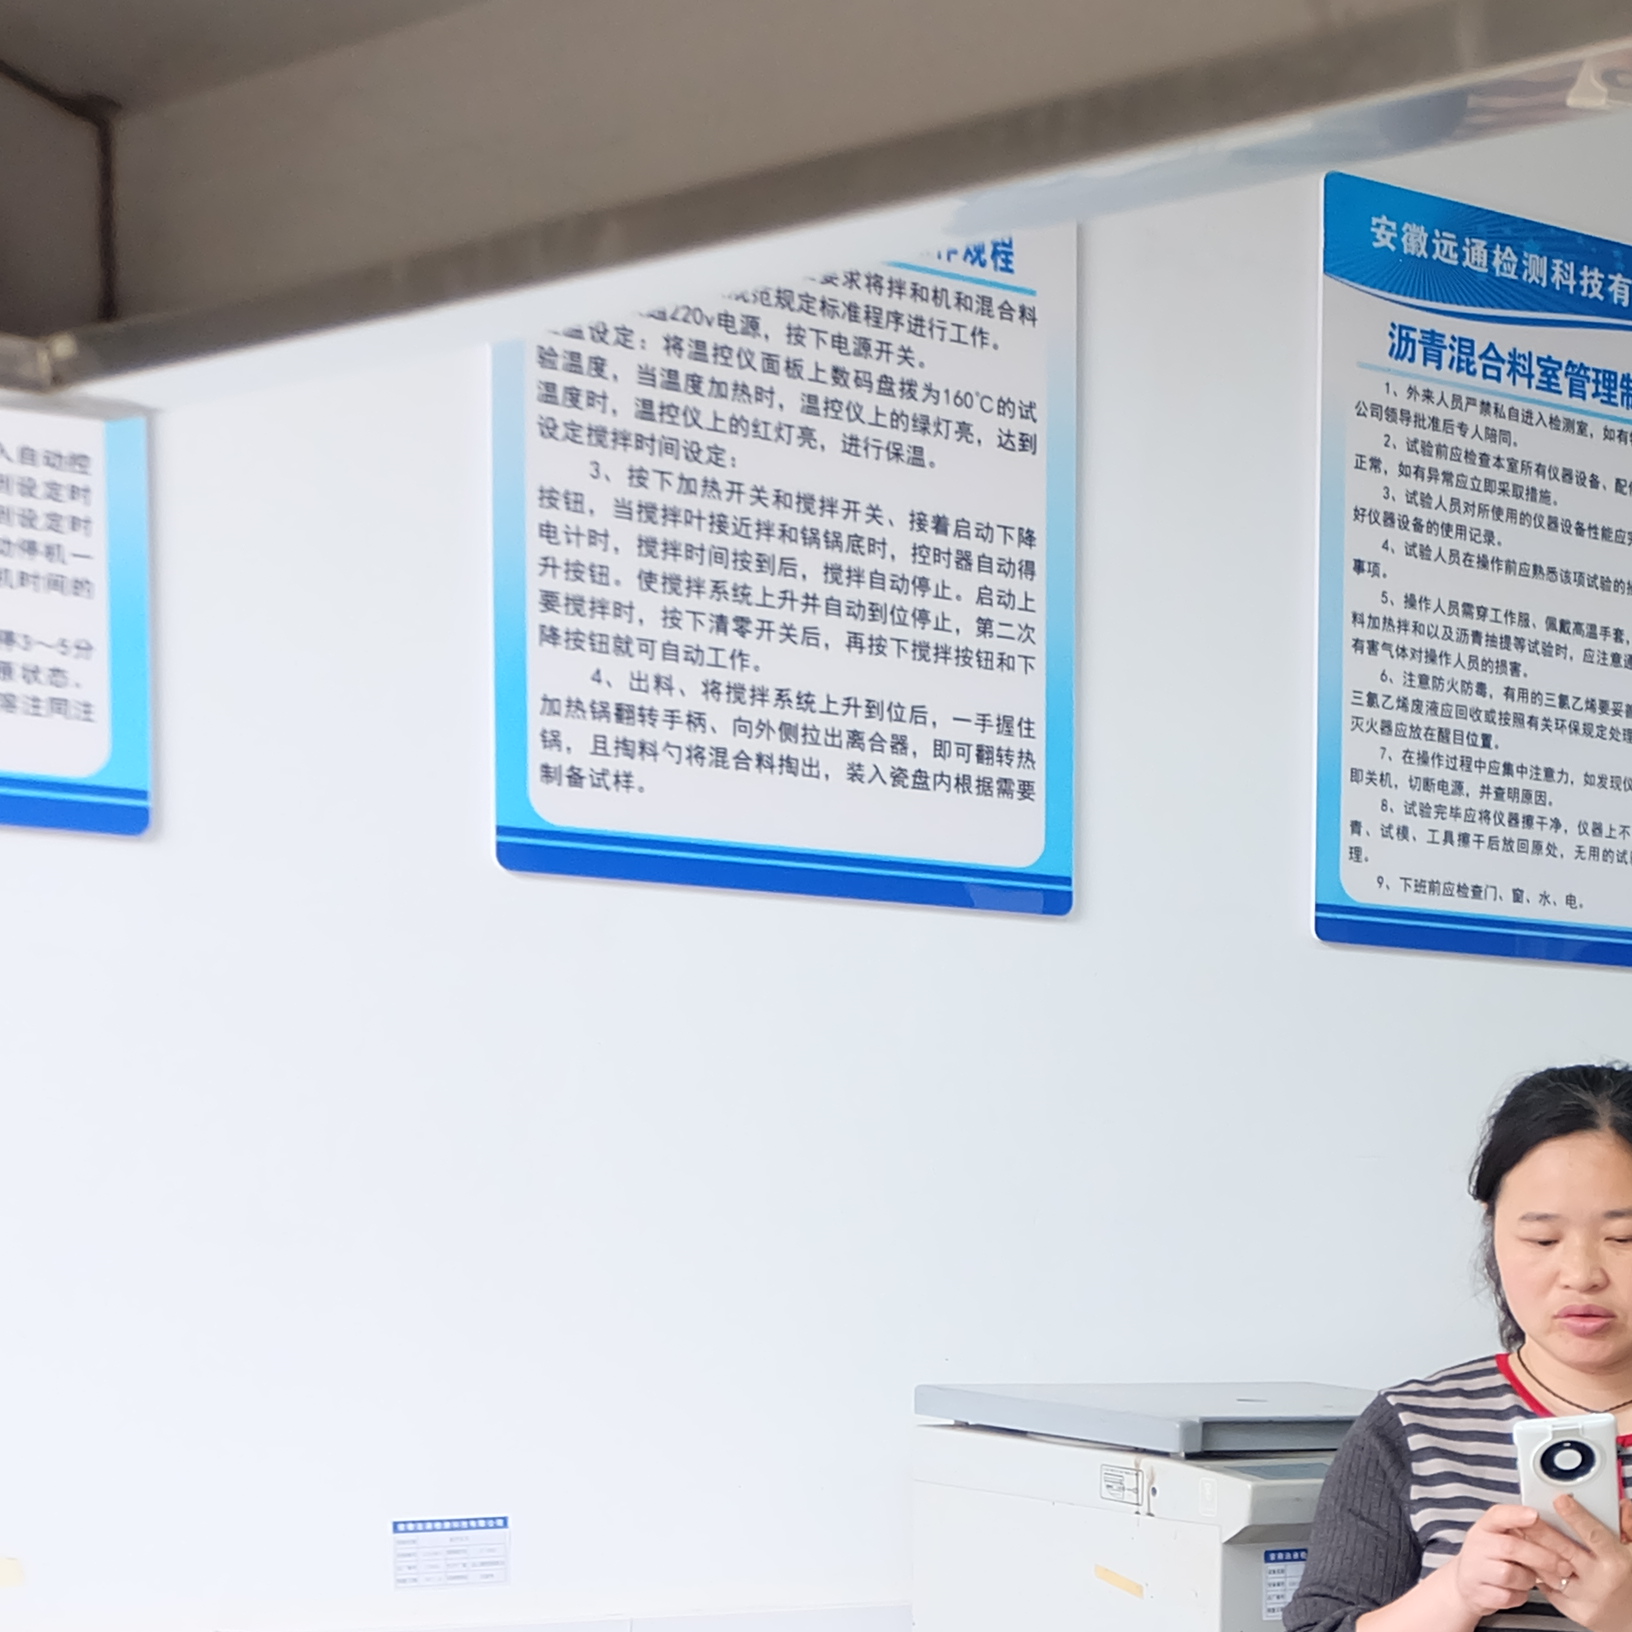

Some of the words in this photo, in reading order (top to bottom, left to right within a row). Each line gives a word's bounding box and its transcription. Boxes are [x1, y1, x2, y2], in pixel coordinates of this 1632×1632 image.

[537, 379, 936, 470] 温度时，温控仪上的红灯亮，进行保温。
[537, 414, 738, 469] 设定搅拌时间设定：
[1354, 400, 1519, 449] 公司领导批准后专人陪同。
[1353, 453, 1559, 507] 正常，如有异常应立即采取措施。
[1352, 505, 1503, 547] 好仪器设备的使用记录。
[1352, 557, 1388, 579] 事项。
[538, 624, 762, 673] 降按钮就可自动工作。
[1351, 637, 1529, 679] 有害气体对操作人员的损害。
[1350, 715, 1500, 750] 灭火器应放在醒目位置。
[539, 761, 646, 795] 制备试样。
[1348, 845, 1370, 864] 理。
